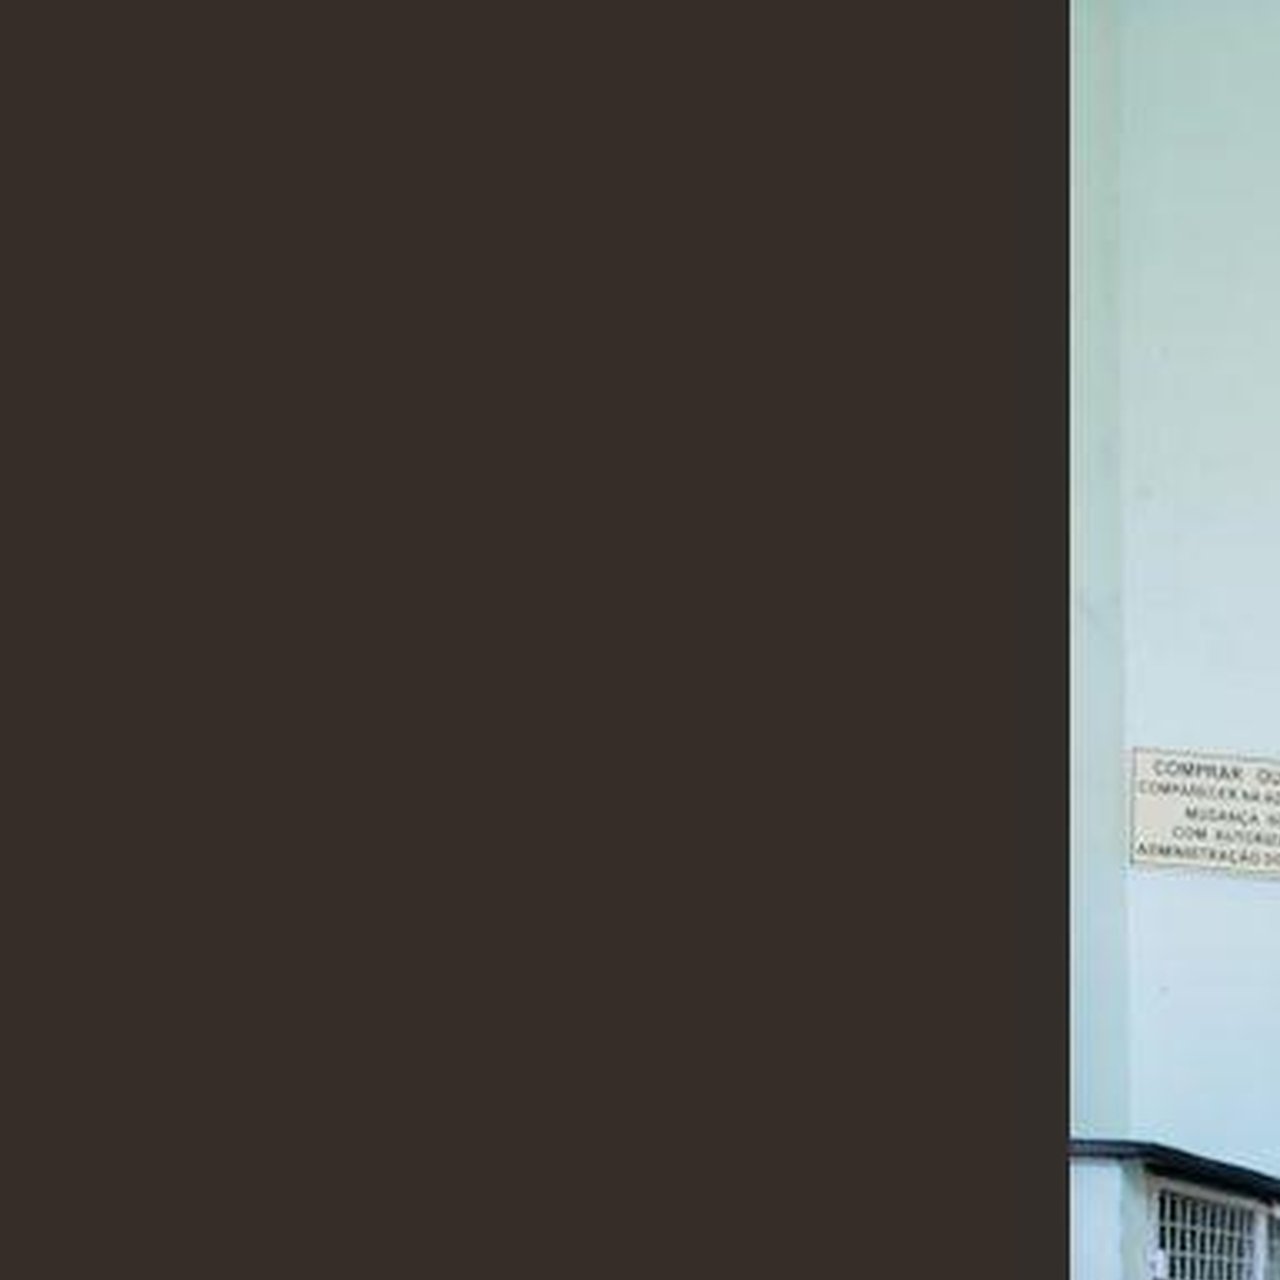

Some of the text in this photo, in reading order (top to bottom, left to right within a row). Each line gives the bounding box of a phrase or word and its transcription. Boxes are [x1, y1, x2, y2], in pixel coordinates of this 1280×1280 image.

[1153, 759, 1243, 780] COMPRAR
[1185, 806, 1260, 827] MUDANÇA
[1172, 826, 1208, 841] COM
